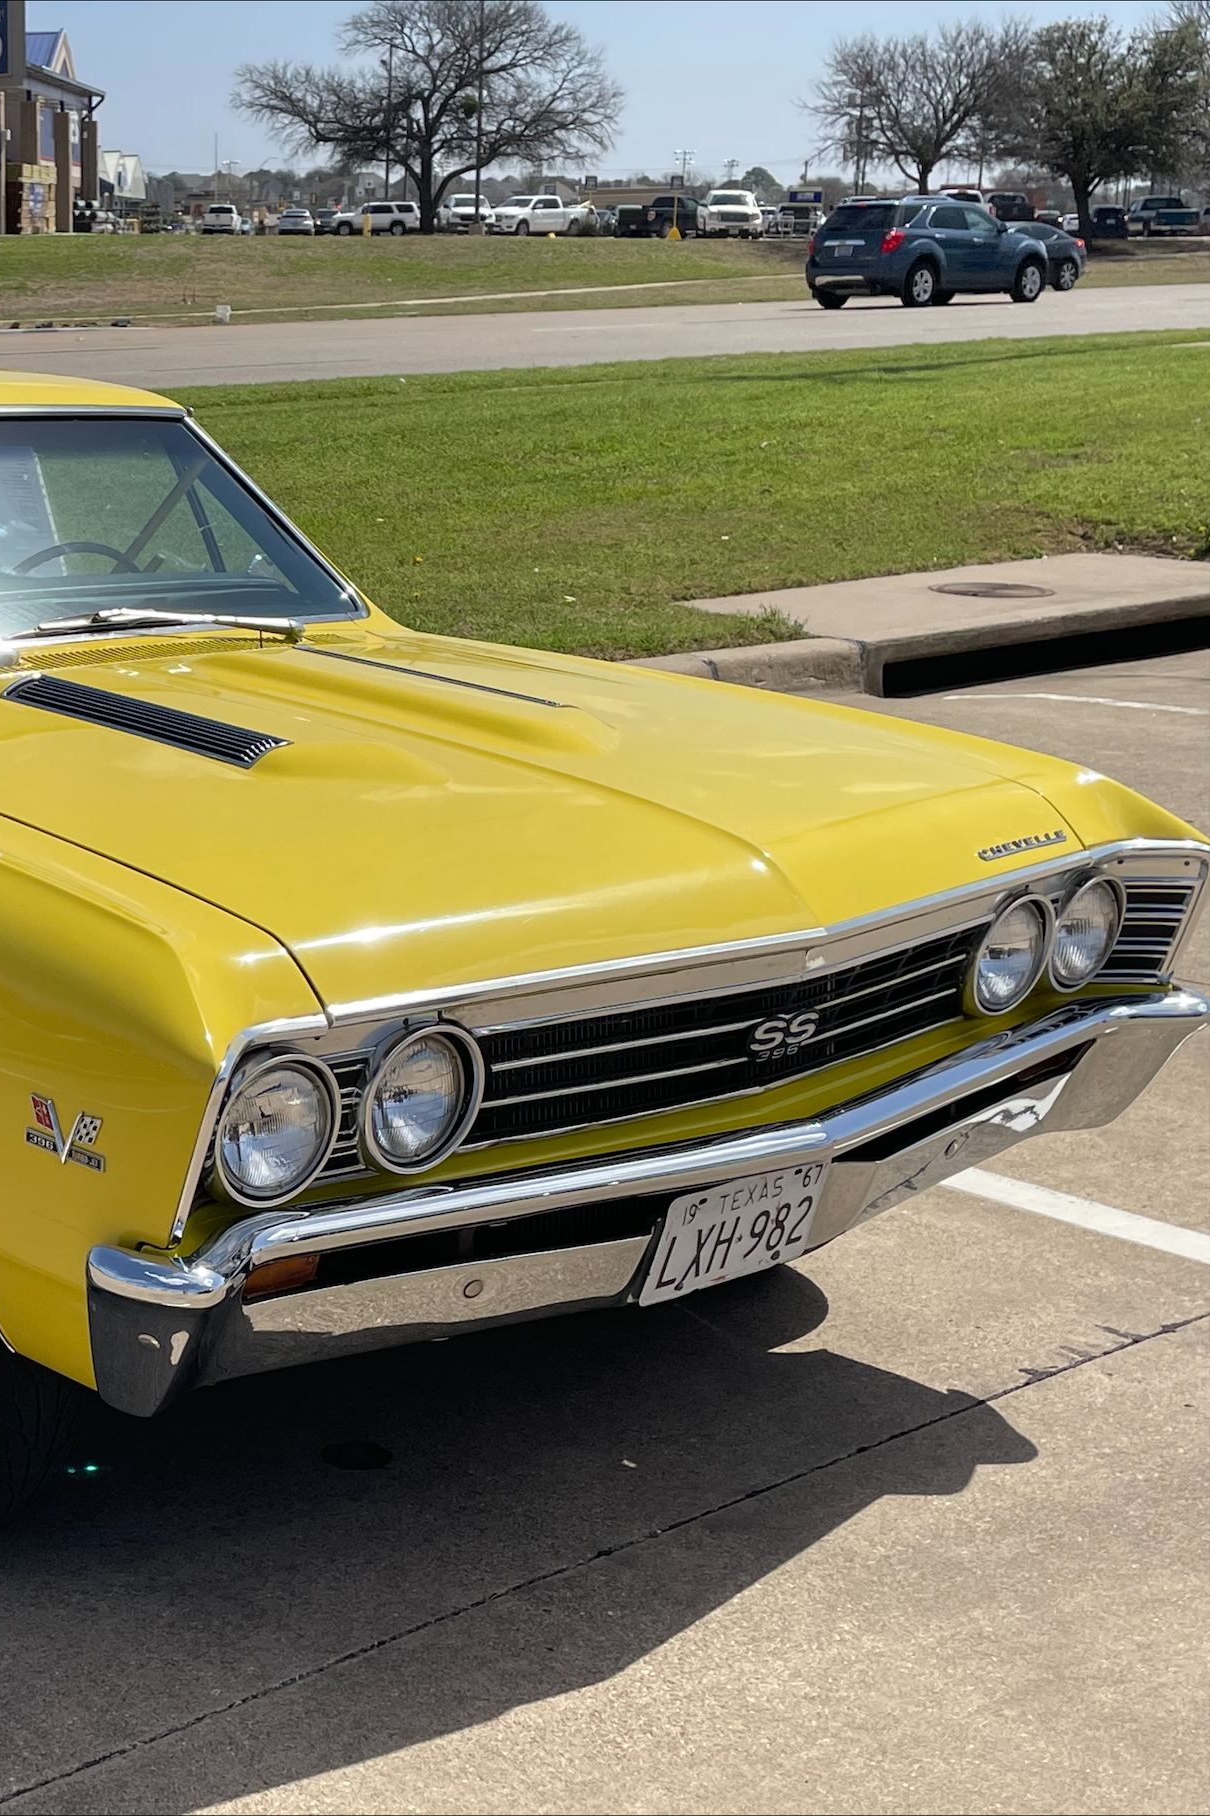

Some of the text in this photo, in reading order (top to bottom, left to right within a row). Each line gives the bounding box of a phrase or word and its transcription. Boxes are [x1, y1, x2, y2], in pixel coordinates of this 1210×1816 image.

[978, 829, 1067, 860] CHEVELLE
[750, 1012, 819, 1051] SS
[756, 1043, 800, 1062] 396
[28, 1133, 55, 1150] 396
[720, 1176, 785, 1215] TEXAS
[802, 1165, 824, 1188] 67
